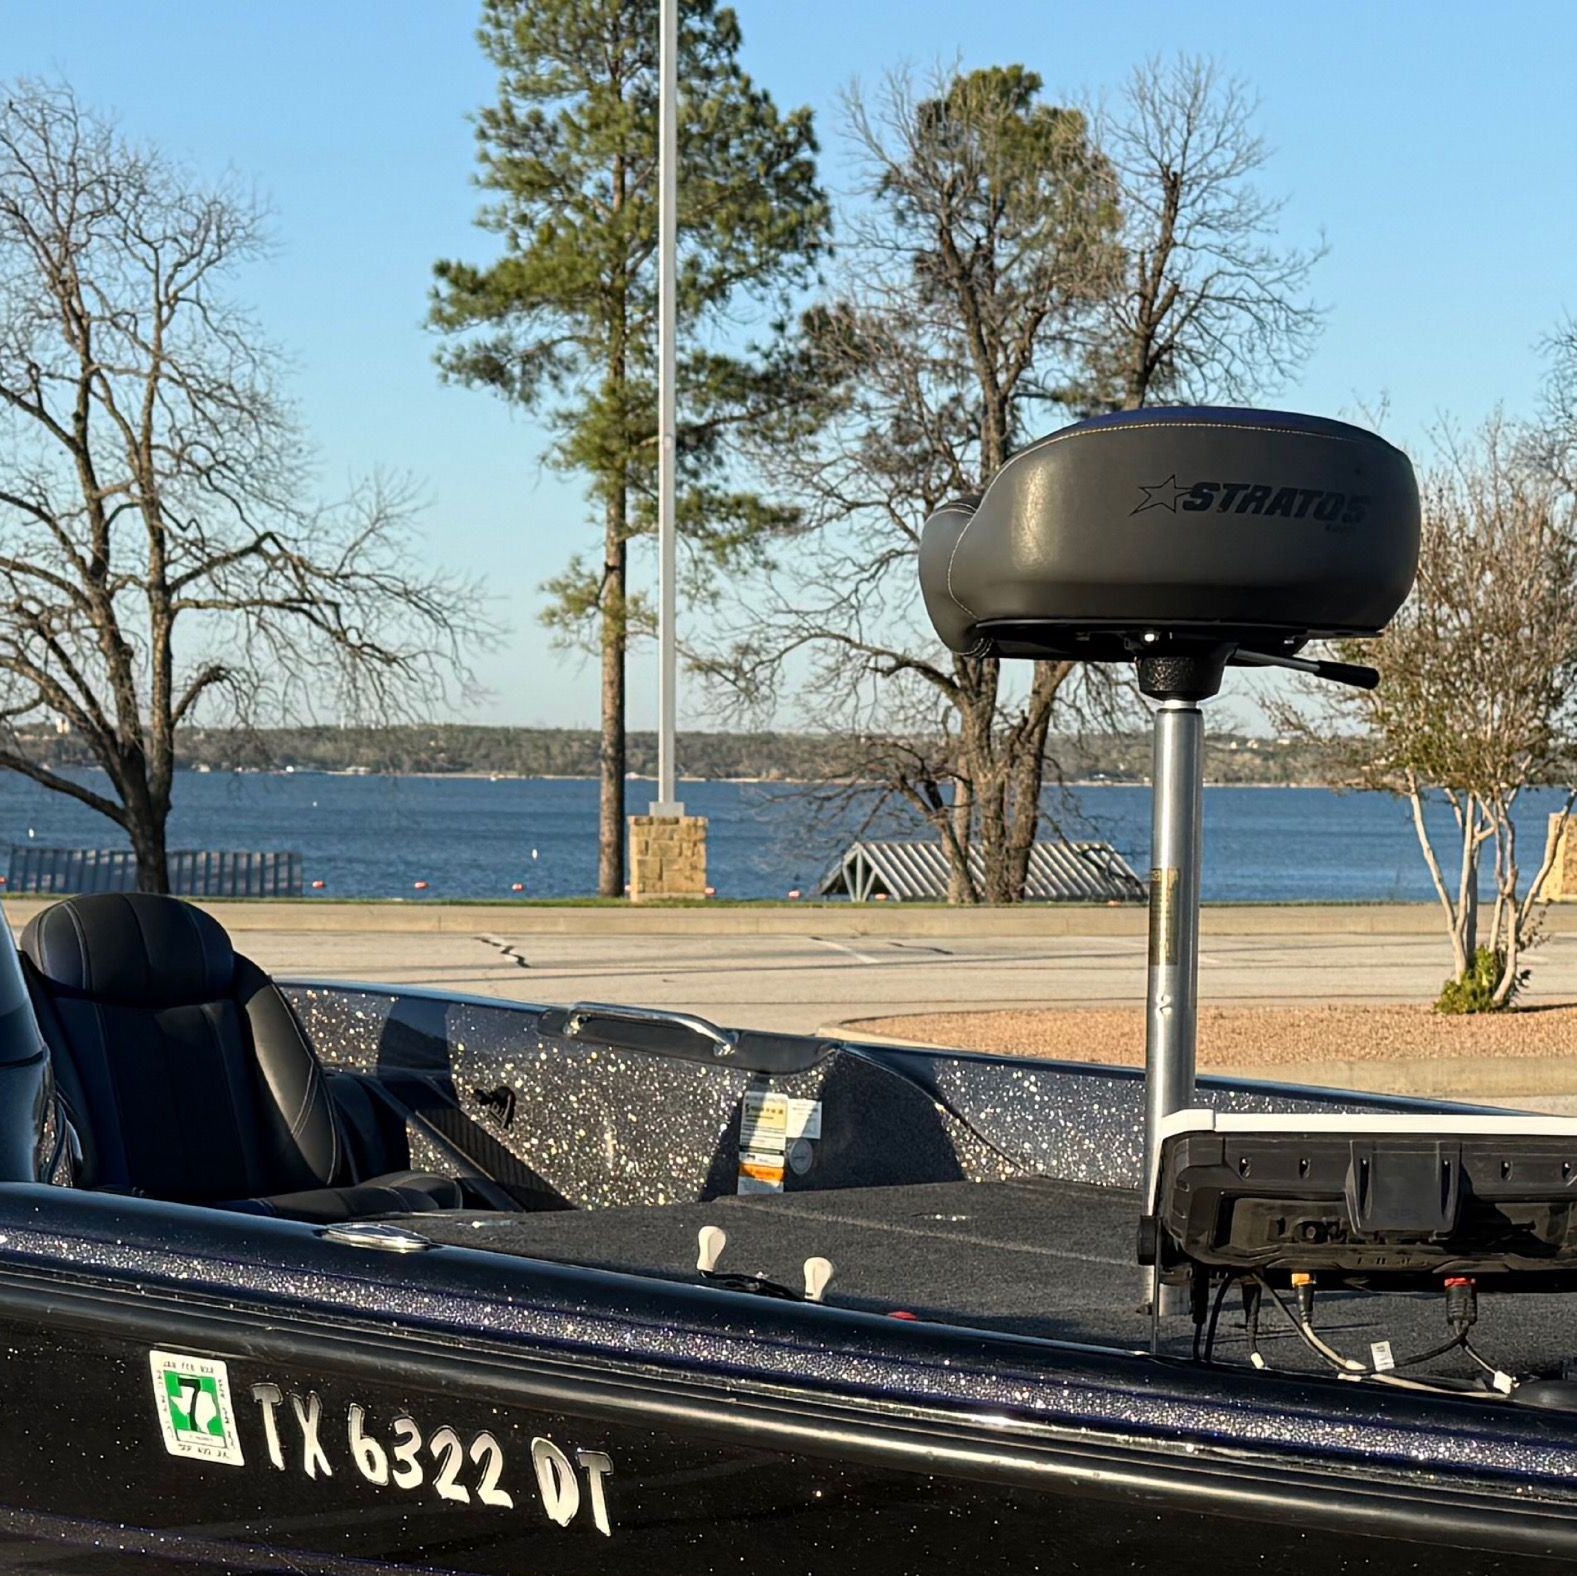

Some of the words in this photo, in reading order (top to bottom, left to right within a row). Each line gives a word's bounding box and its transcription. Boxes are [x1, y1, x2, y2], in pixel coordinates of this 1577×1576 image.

[1181, 481, 1371, 525] STRATOS
[177, 1377, 201, 1432] 7
[249, 1382, 333, 1481] TX
[348, 1402, 514, 1509] 6322
[531, 1436, 614, 1537] DT
